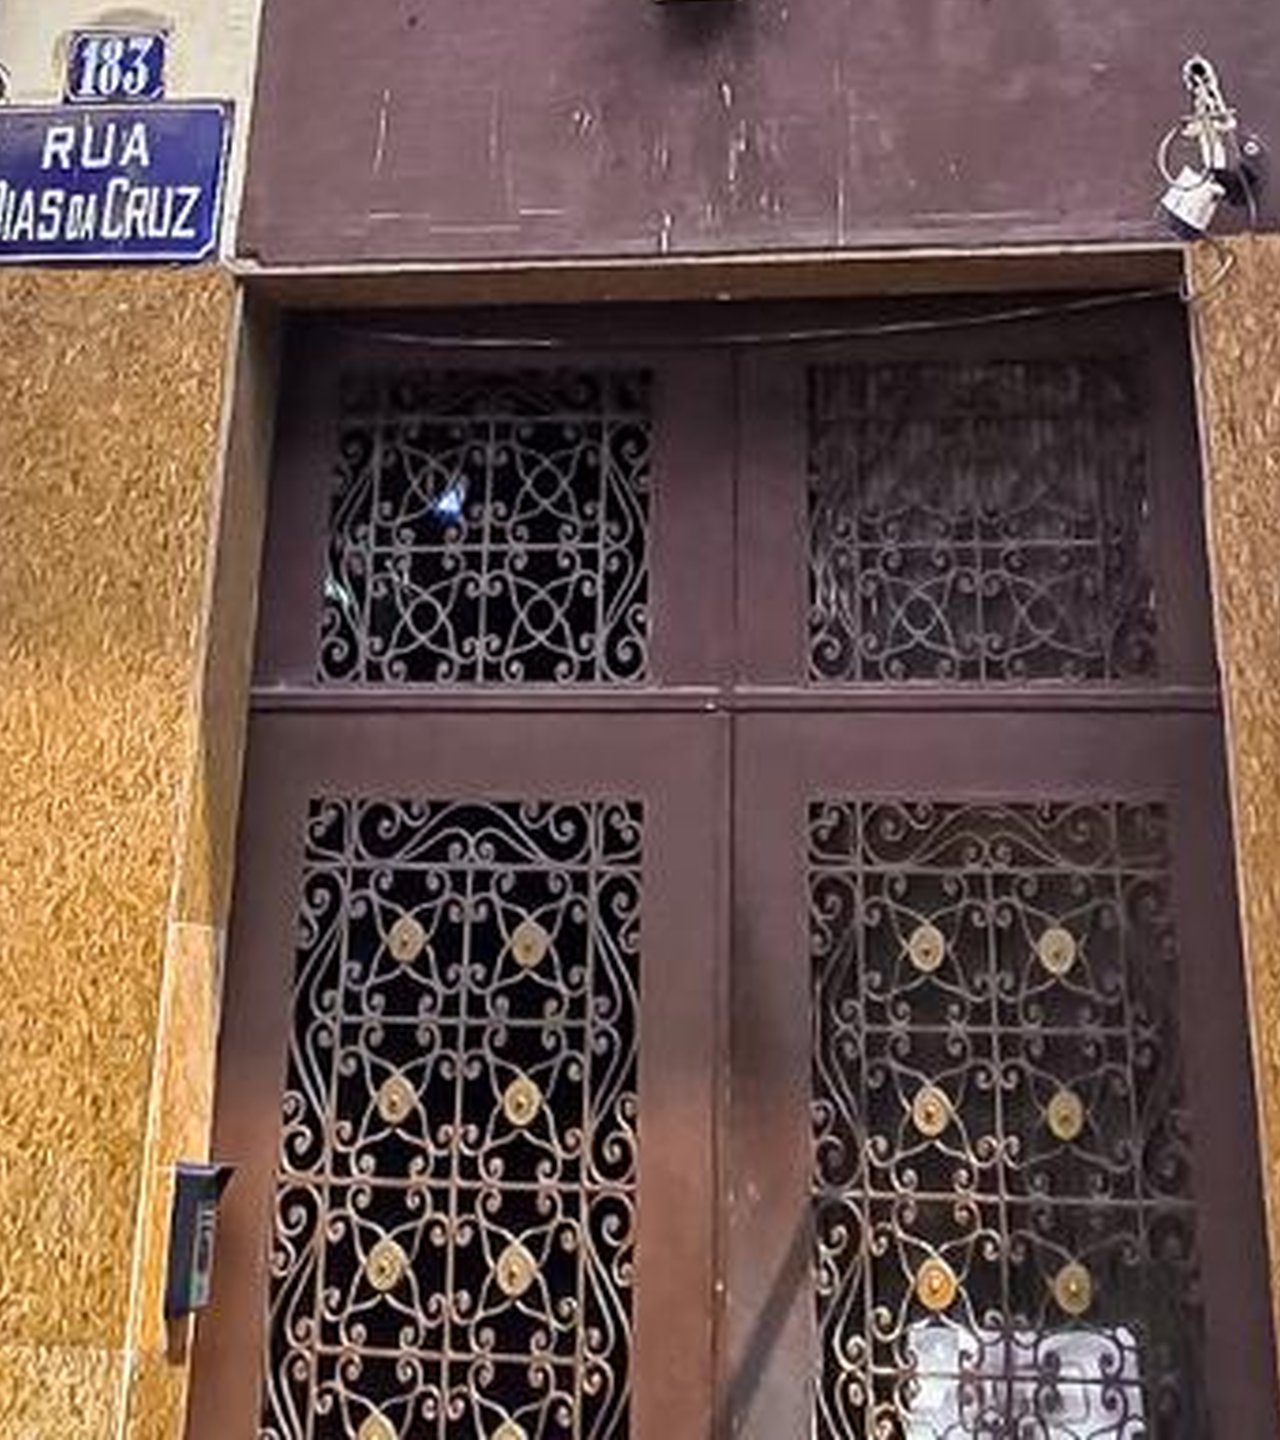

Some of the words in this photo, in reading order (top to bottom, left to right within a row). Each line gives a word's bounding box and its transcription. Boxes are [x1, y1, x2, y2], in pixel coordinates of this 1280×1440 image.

[78, 36, 154, 96] 183
[41, 122, 151, 170] RUA
[102, 177, 202, 239] CRUZ
